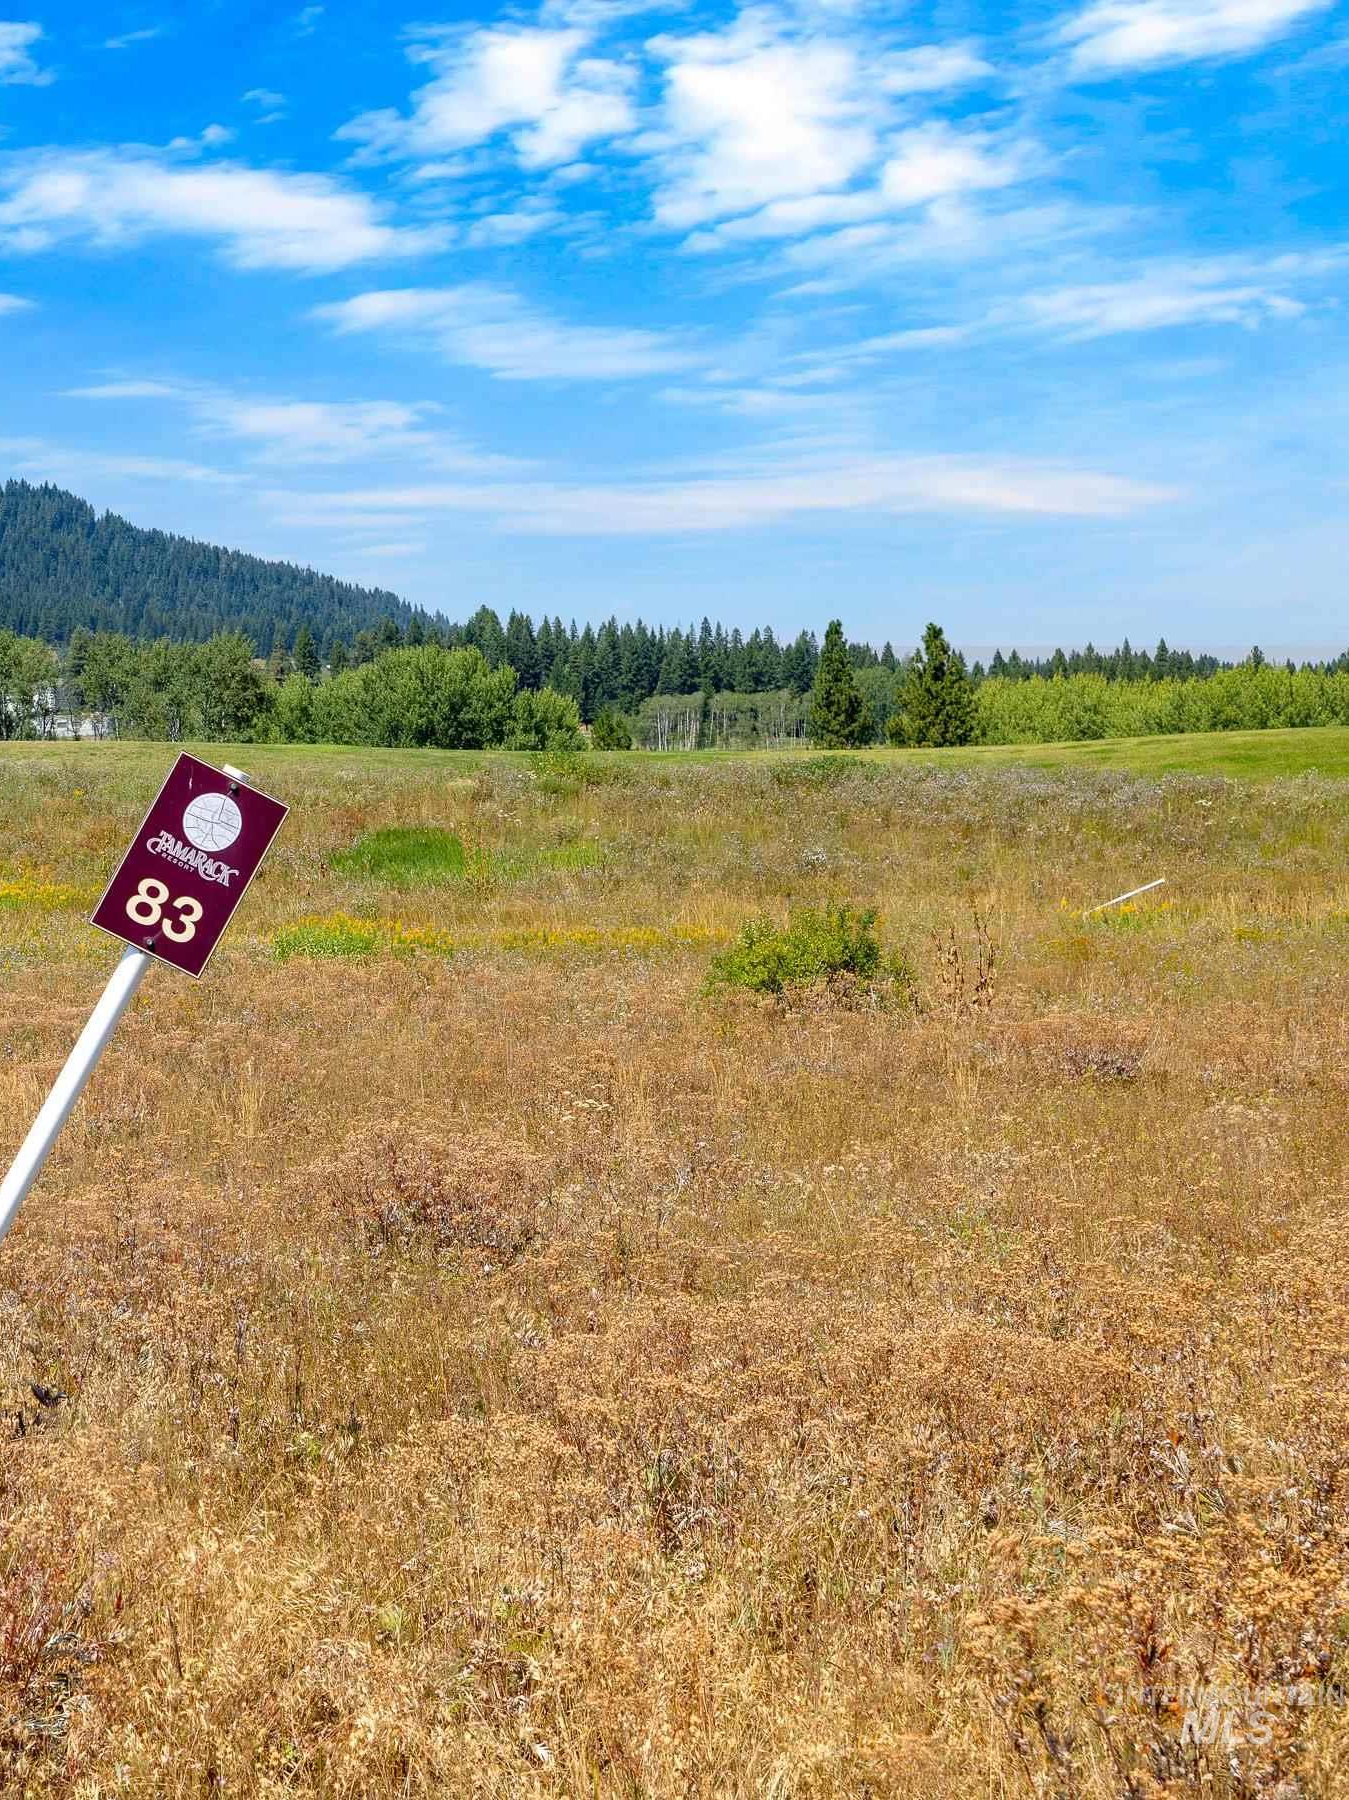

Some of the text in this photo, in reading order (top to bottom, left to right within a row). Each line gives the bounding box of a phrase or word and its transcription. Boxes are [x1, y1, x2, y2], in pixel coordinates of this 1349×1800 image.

[146, 830, 240, 887] TAMARACK
[161, 852, 195, 873] RESORT
[125, 878, 204, 943] 83
